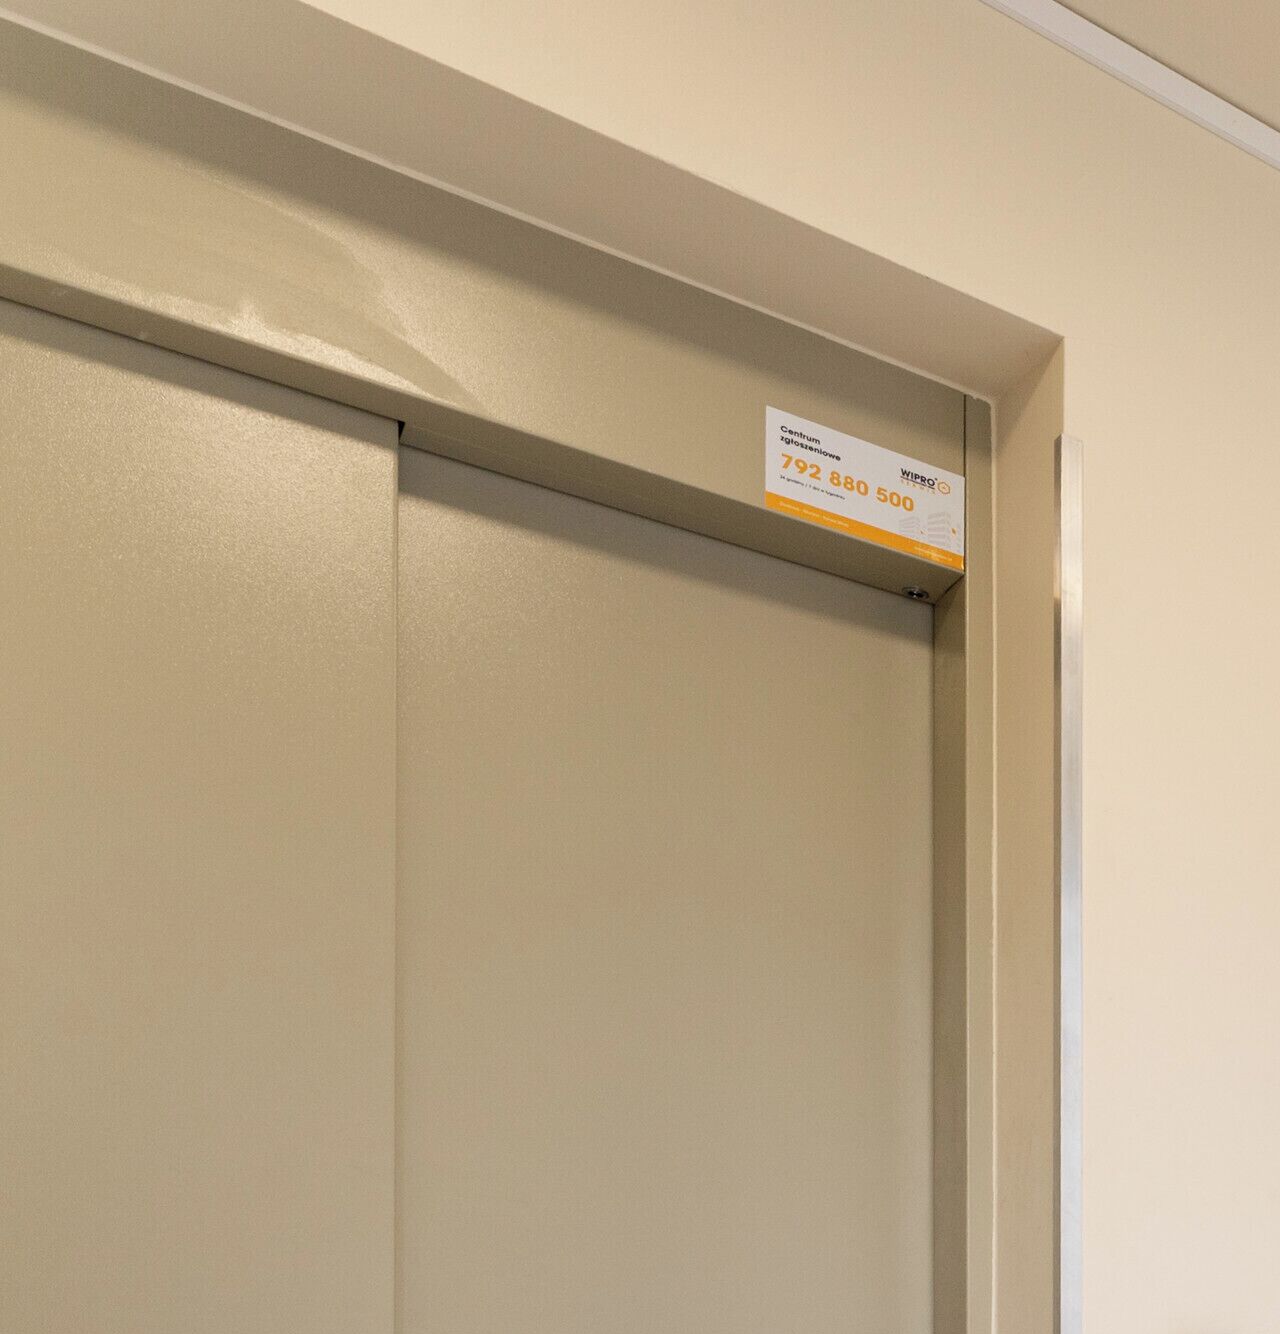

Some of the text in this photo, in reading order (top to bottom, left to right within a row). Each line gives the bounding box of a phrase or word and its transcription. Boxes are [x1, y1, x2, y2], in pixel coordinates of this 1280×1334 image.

[780, 426, 820, 446] Centrum
[780, 436, 842, 462] zgłoszeniowe
[781, 453, 914, 512] 792 880 500
[900, 468, 935, 486] WIPRO
